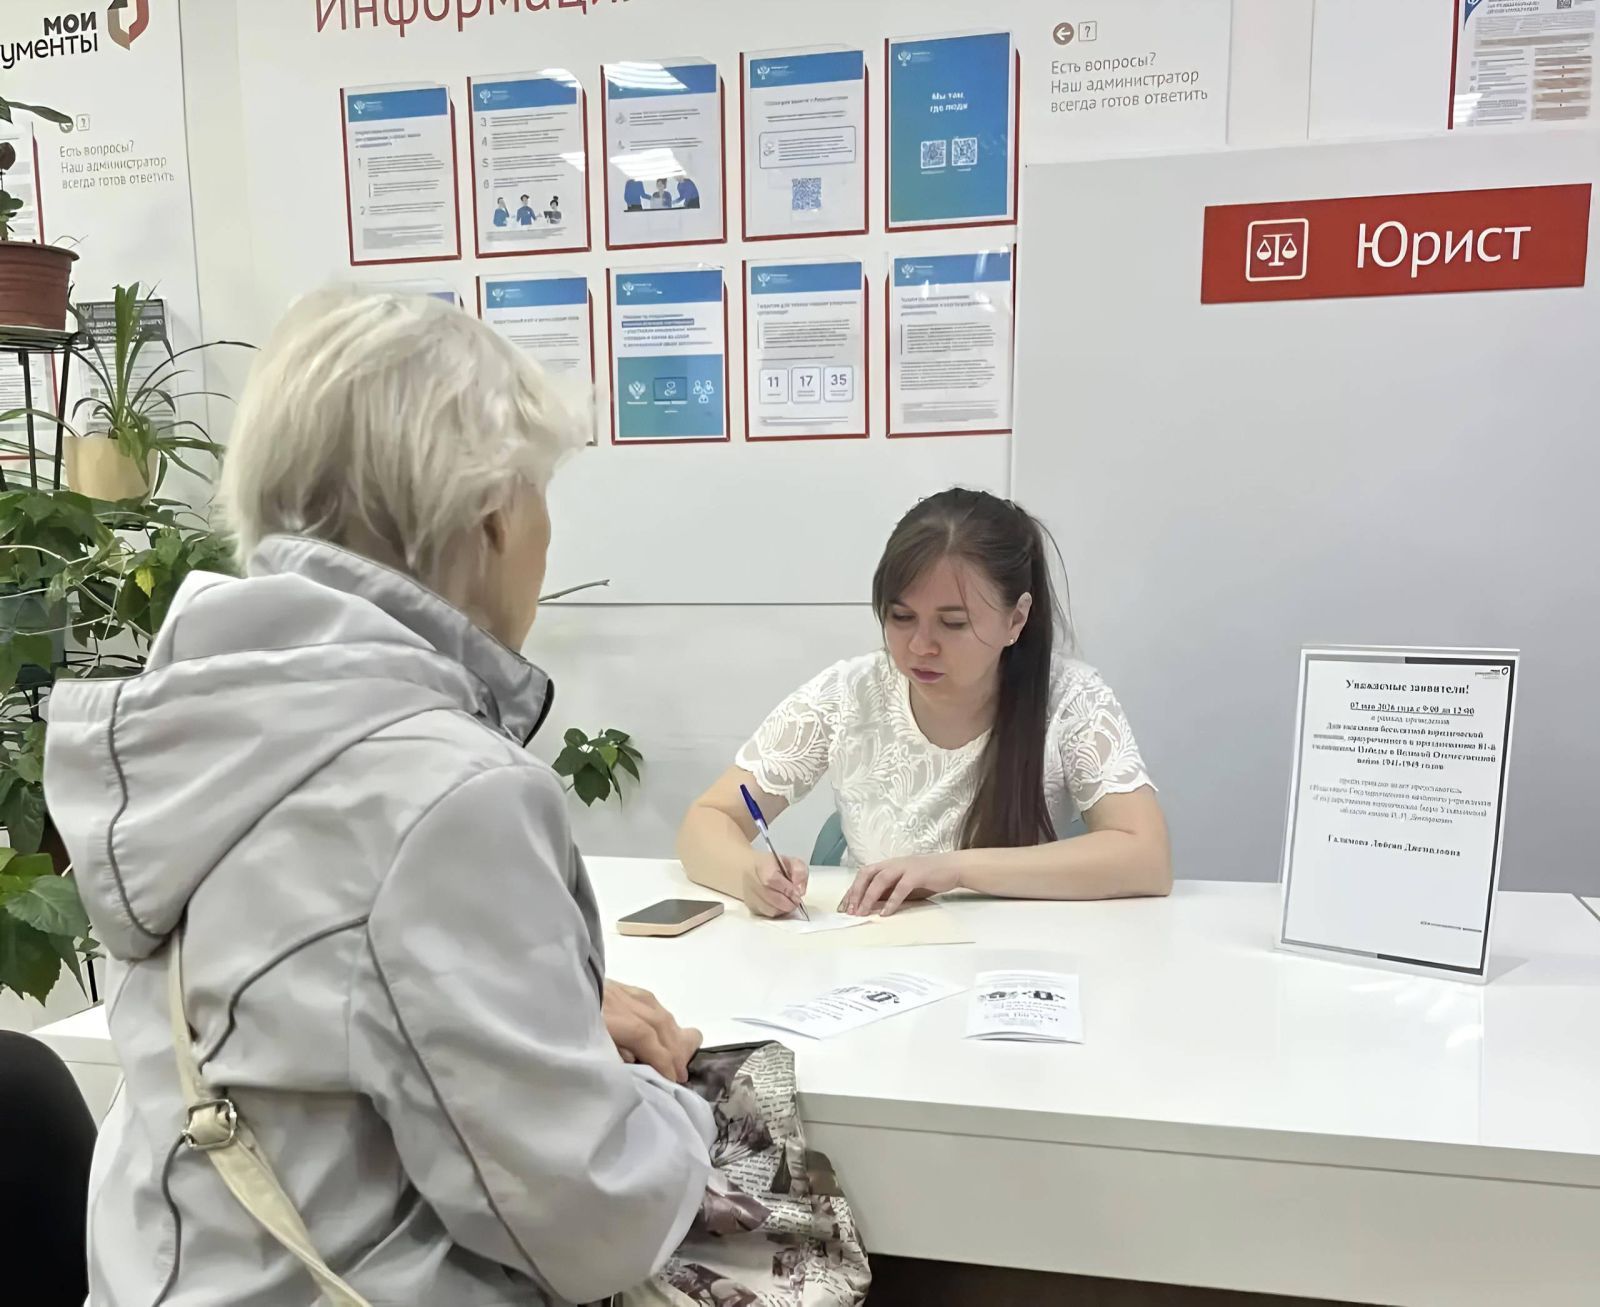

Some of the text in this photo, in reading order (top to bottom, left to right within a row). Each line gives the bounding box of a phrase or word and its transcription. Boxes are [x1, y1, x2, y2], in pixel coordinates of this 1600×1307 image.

[1051, 51, 1157, 75] Есть вопросы?
[1051, 70, 1199, 94] Наш администратор
[1051, 89, 1208, 114] всегда готов ответить
[60, 140, 134, 158] Есть вопросы?
[61, 156, 167, 174] Наш администратор
[62, 171, 175, 189] всегда готов ответить
[1357, 220, 1532, 278] Юрист
[767, 376, 780, 388] 11
[800, 375, 814, 387] 17
[830, 374, 847, 386] 35
